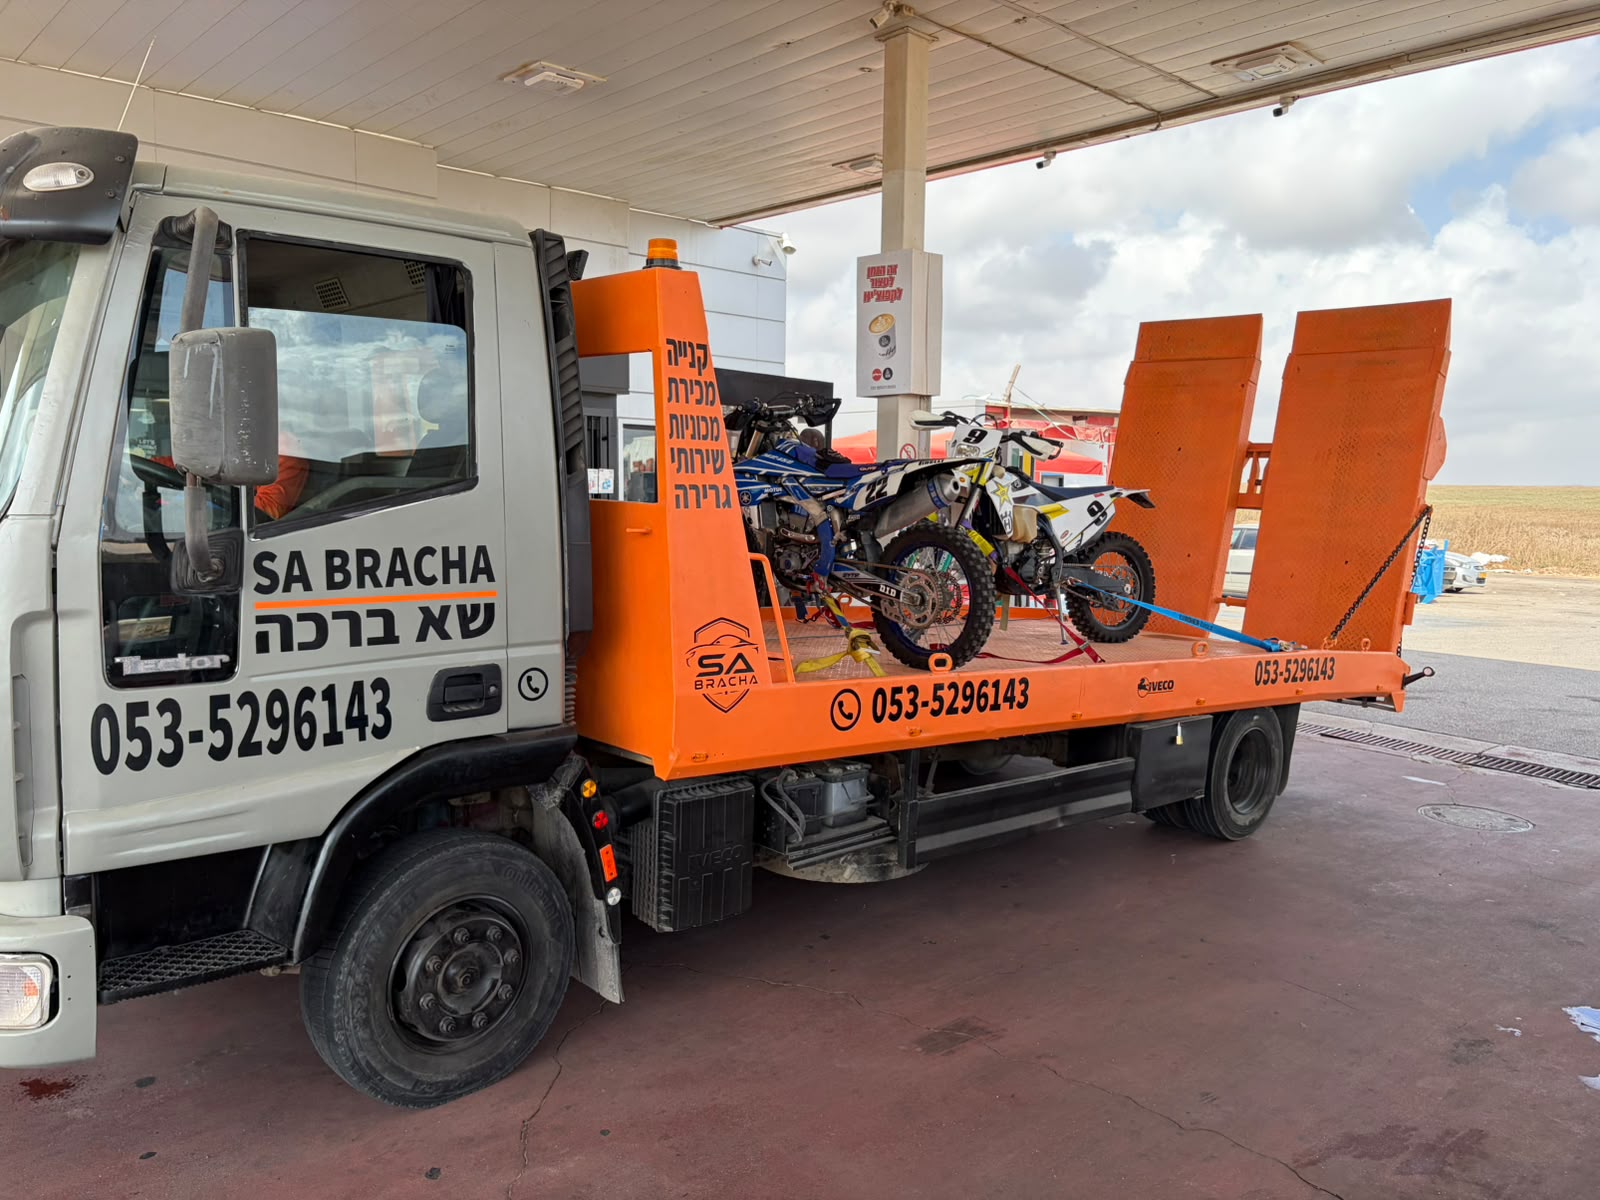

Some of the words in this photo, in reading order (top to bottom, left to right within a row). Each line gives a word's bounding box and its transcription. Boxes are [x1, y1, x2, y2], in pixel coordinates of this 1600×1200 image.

[666, 338, 708, 376] קנייה
[667, 377, 716, 407] מכירת
[669, 413, 720, 442] מכוניות
[963, 428, 988, 444] 9
[670, 447, 725, 475] שירותי
[675, 483, 732, 509] גרירה
[865, 476, 888, 504] 22
[253, 551, 313, 595] SA
[325, 545, 496, 591] BRACHA
[255, 608, 400, 655] ברכה
[415, 602, 496, 643] שא
[696, 653, 755, 678] SA
[1255, 656, 1335, 687] 053-5296143
[694, 675, 758, 690] BRACHA
[872, 677, 1030, 724] 053-5296143
[90, 677, 392, 775] 053-5296143
